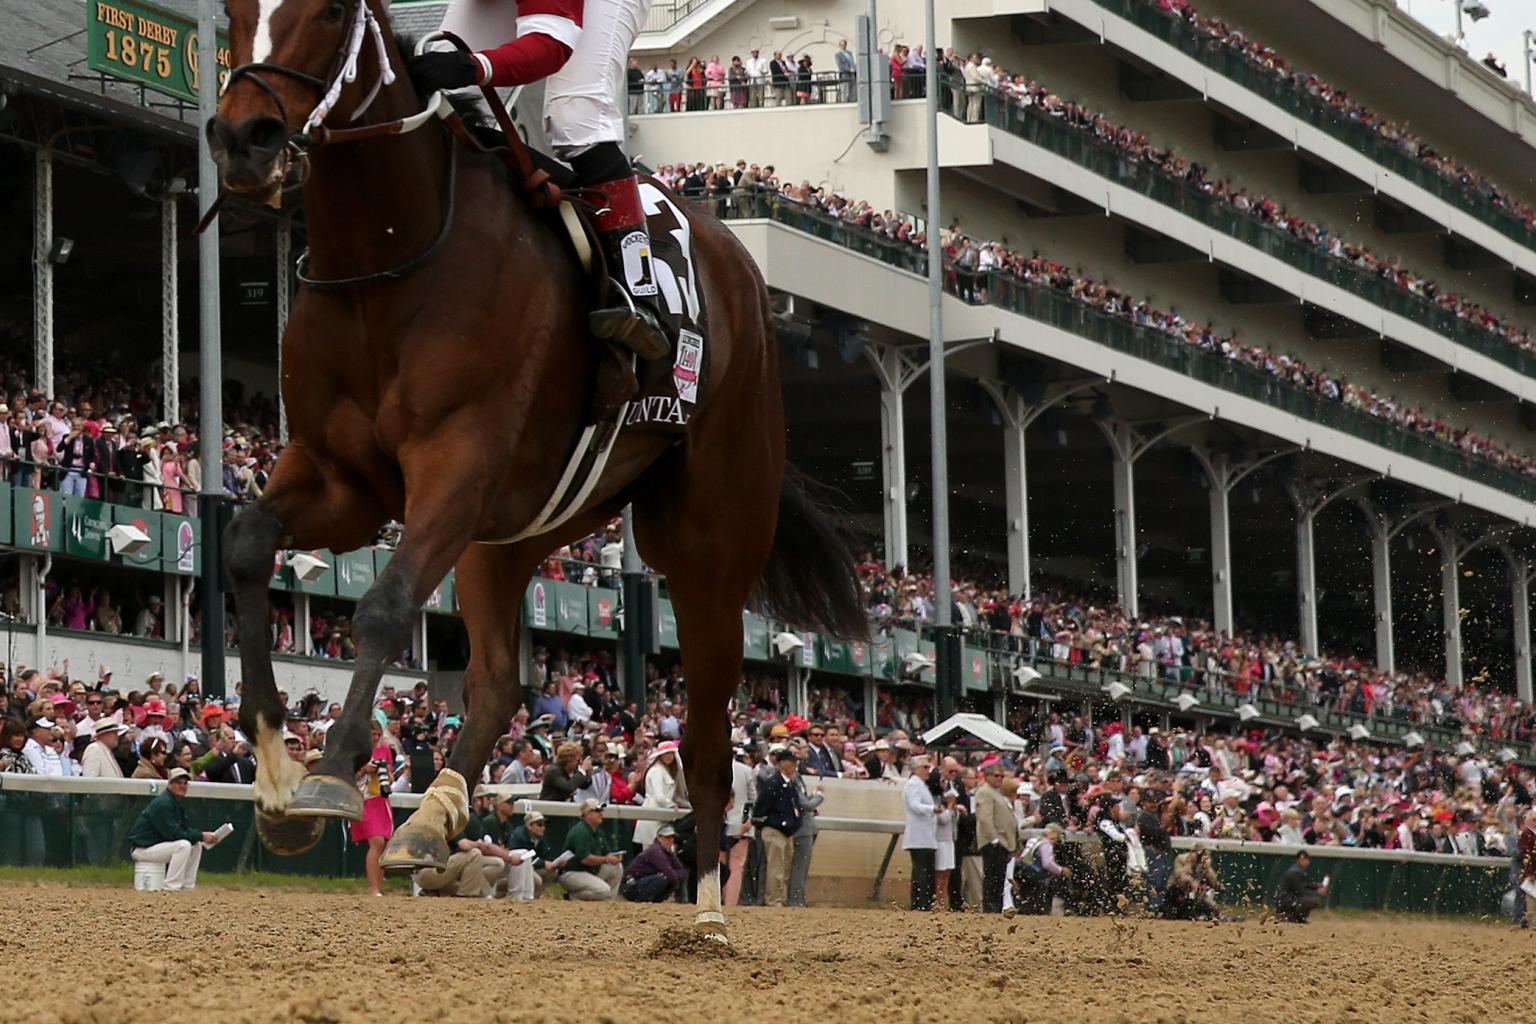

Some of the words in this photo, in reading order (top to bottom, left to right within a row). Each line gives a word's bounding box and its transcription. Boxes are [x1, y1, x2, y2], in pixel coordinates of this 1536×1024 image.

[97, 2, 135, 32] FIRST
[138, 17, 178, 48] DERBY
[106, 30, 171, 78] 1875
[632, 285, 656, 295] GUILD
[626, 396, 691, 426] UNTA
